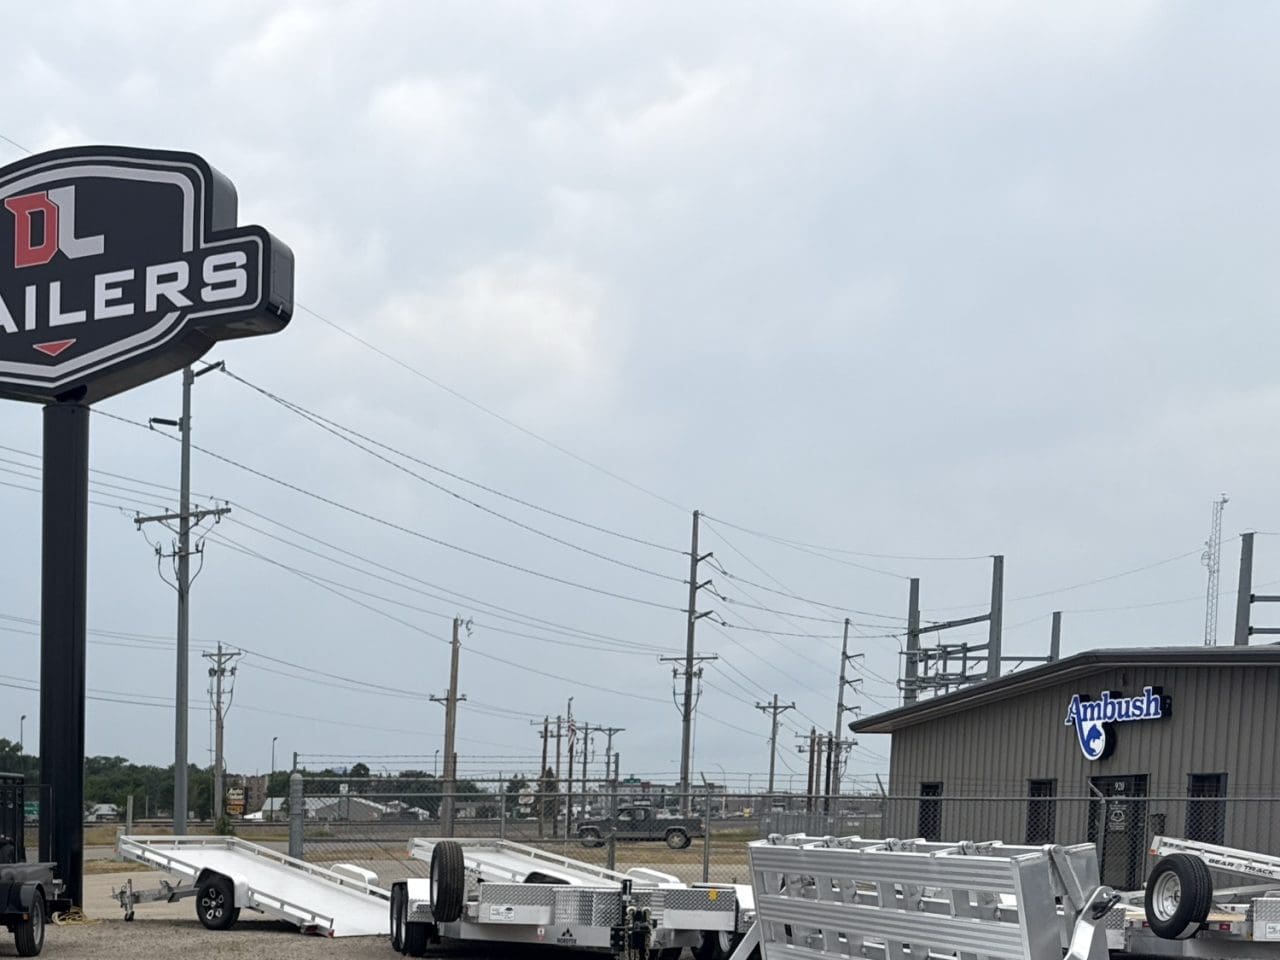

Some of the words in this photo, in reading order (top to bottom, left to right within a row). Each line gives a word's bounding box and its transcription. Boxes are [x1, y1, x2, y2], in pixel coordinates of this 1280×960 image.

[5, 185, 105, 269] DL
[1064, 686, 1162, 727] Ambush
[1208, 858, 1235, 868] BEAR
[1243, 865, 1275, 876] TRACK
